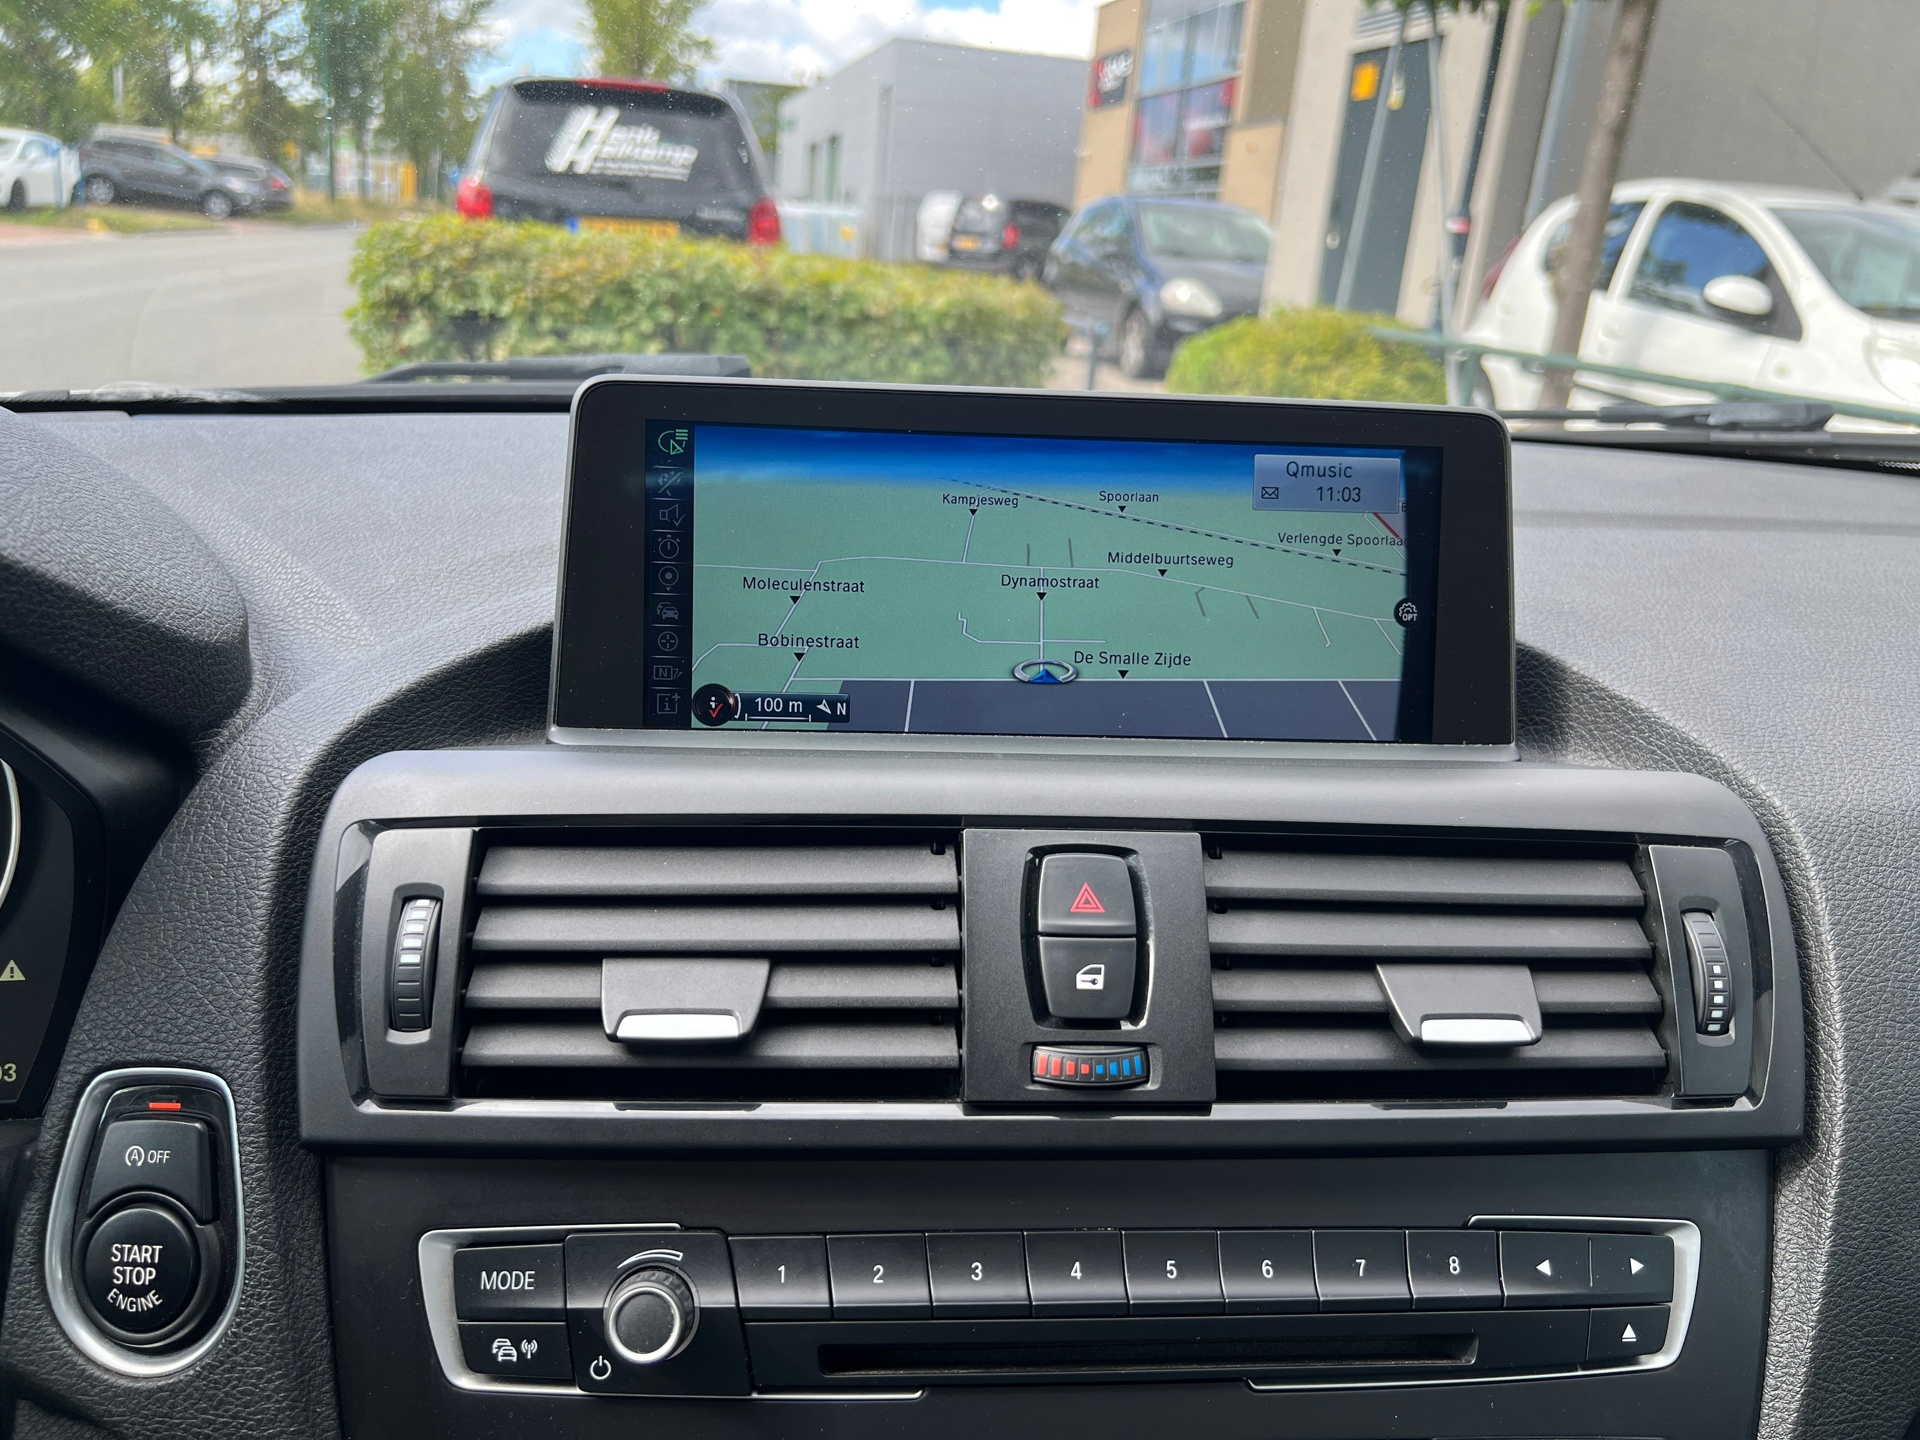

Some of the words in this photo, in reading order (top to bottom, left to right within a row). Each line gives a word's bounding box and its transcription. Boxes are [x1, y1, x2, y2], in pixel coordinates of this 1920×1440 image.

[1286, 461, 1353, 478] Qmusic
[942, 493, 1019, 508] Kampjesweg
[1099, 490, 1159, 504] Spoorlaan
[1316, 486, 1361, 502] 11:03
[1278, 532, 1343, 546] Verlengde
[1107, 552, 1234, 568] Middelbuurtseweg
[743, 577, 865, 592] Moleculenstraat
[1001, 574, 1099, 589] Dynamostraat
[1402, 613, 1418, 621] OPT
[758, 633, 859, 649] Bobinestraat
[1074, 650, 1094, 664] De
[1098, 651, 1149, 665] Smalle
[1154, 652, 1191, 668] Zijde
[755, 697, 783, 712] 100
[789, 701, 802, 713] m
[837, 702, 846, 715] N
[0, 1063, 17, 1082] 3
[147, 1150, 171, 1164] OFF
[111, 1243, 163, 1264] START
[971, 1262, 983, 1281] 3
[1070, 1261, 1082, 1280] 4
[1166, 1260, 1177, 1279] 5
[1262, 1259, 1274, 1278] 6
[1355, 1259, 1366, 1277] 7
[1449, 1256, 1460, 1274] 8
[113, 1266, 156, 1285] STOP
[480, 1269, 537, 1291] MODE
[777, 1265, 786, 1284] 1
[873, 1265, 884, 1284] 2
[107, 1288, 163, 1312] ENGINE
